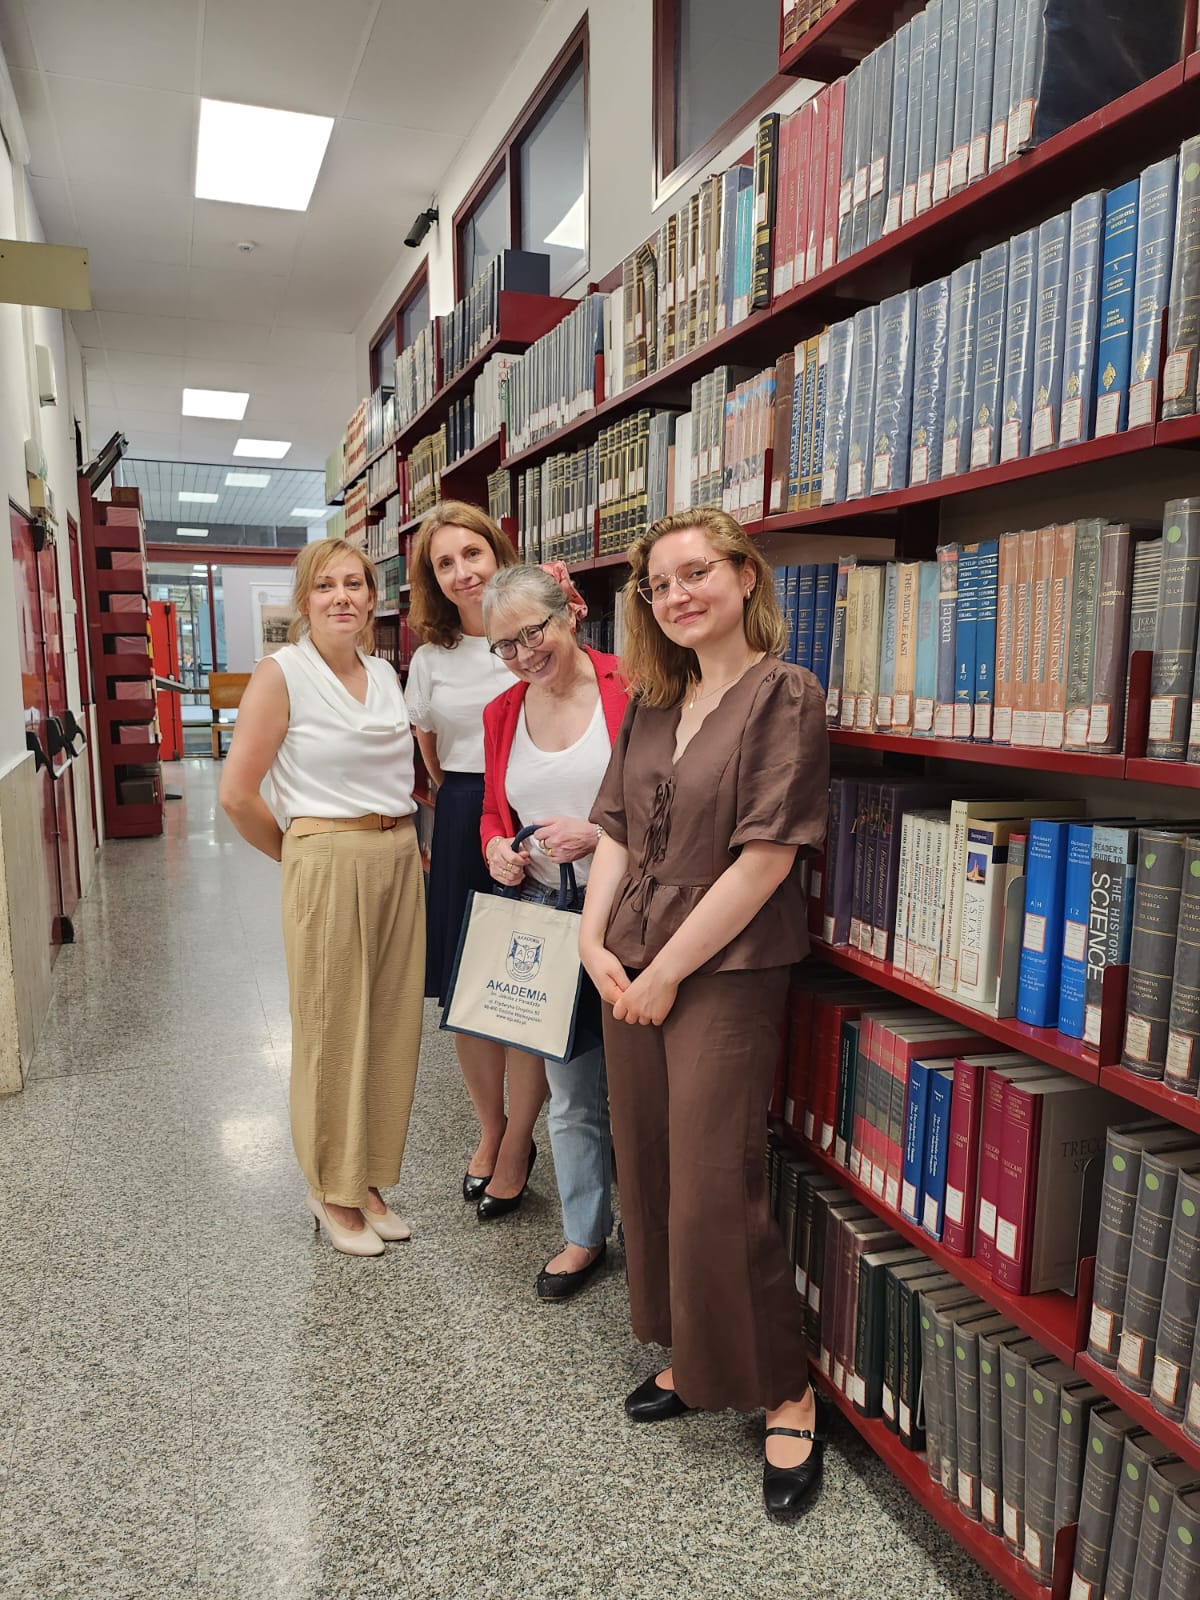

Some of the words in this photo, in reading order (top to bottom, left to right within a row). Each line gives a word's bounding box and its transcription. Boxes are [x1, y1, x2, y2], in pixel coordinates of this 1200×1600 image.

[888, 576, 896, 609] LATIN
[902, 594, 912, 628] MIDDLE
[1054, 578, 1063, 631] RUSSIAN
[834, 608, 844, 648] Russia
[886, 611, 896, 664] AMERICA
[920, 600, 931, 640] INDIA
[940, 603, 956, 643] Japan
[901, 628, 909, 656] EAST
[1050, 633, 1060, 680] HISTORY
[960, 664, 966, 673] 1
[1094, 843, 1124, 854] READER'S
[1111, 876, 1122, 902] THE
[967, 896, 978, 948] ASIAN
[1087, 872, 1110, 984] SCIENCE
[1108, 908, 1120, 966] HISTORY
[486, 979, 548, 1003] AKADEMIA
